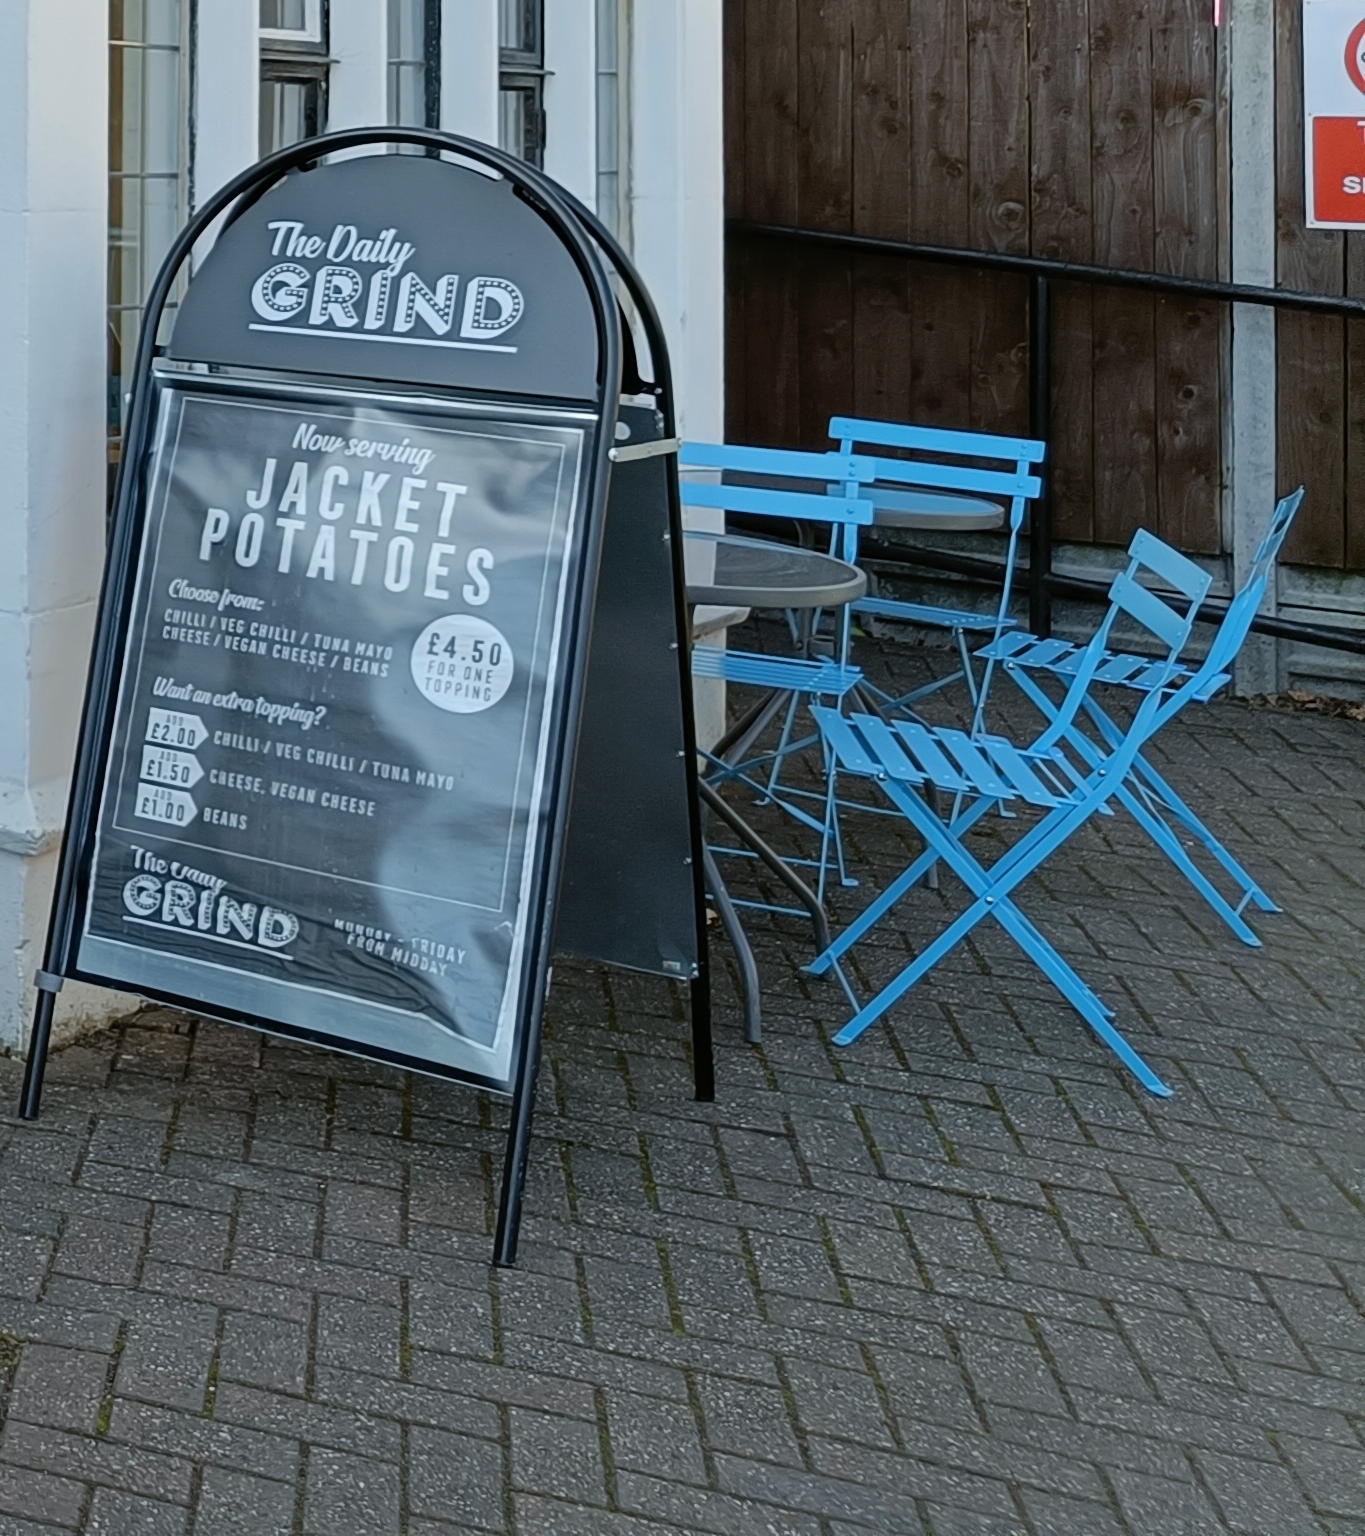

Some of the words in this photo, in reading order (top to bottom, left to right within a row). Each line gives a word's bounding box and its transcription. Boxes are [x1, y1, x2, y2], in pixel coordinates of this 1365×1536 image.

[268, 221, 326, 258] The
[326, 224, 416, 277] Daily
[250, 263, 524, 339] GRIND
[292, 423, 343, 451] Now
[348, 438, 436, 475] serving
[246, 458, 467, 538] JACKET
[199, 508, 494, 605] POTATOES
[169, 578, 219, 604] Choose
[218, 588, 265, 611] from:
[162, 625, 211, 646] CHEESE
[224, 635, 267, 656] VEGAN
[272, 644, 326, 667] CHEESE
[343, 656, 390, 678] BEANS
[164, 608, 206, 629] CHILLI
[221, 617, 245, 634] VEG
[249, 621, 296, 644] CHILLI
[314, 633, 350, 653] TUNA
[354, 642, 393, 661] MAYO
[427, 632, 502, 666] £4.50
[425, 677, 492, 702] TOPPING
[427, 660, 456, 677] FOR
[463, 666, 493, 684] ONE
[152, 676, 194, 701] Want
[192, 689, 211, 705] an
[212, 691, 255, 712] extra
[255, 695, 327, 730] topping?
[151, 722, 196, 746] £2.00
[146, 759, 190, 783] £1.50
[213, 730, 259, 754] CHILLI
[276, 742, 301, 761] VEG
[306, 748, 355, 772] CHILLI
[372, 761, 410, 783] TUNA
[415, 770, 455, 792] MAYO
[141, 797, 185, 821] £1.00
[203, 807, 248, 830] BEANS
[270, 781, 316, 804] VEGAN
[320, 792, 376, 817] CHEESE
[130, 845, 169, 874] The
[122, 874, 300, 949] GRIND
[347, 932, 385, 957] FROM
[391, 946, 448, 977] MIDDAY
[411, 937, 466, 965] FRIDAY
